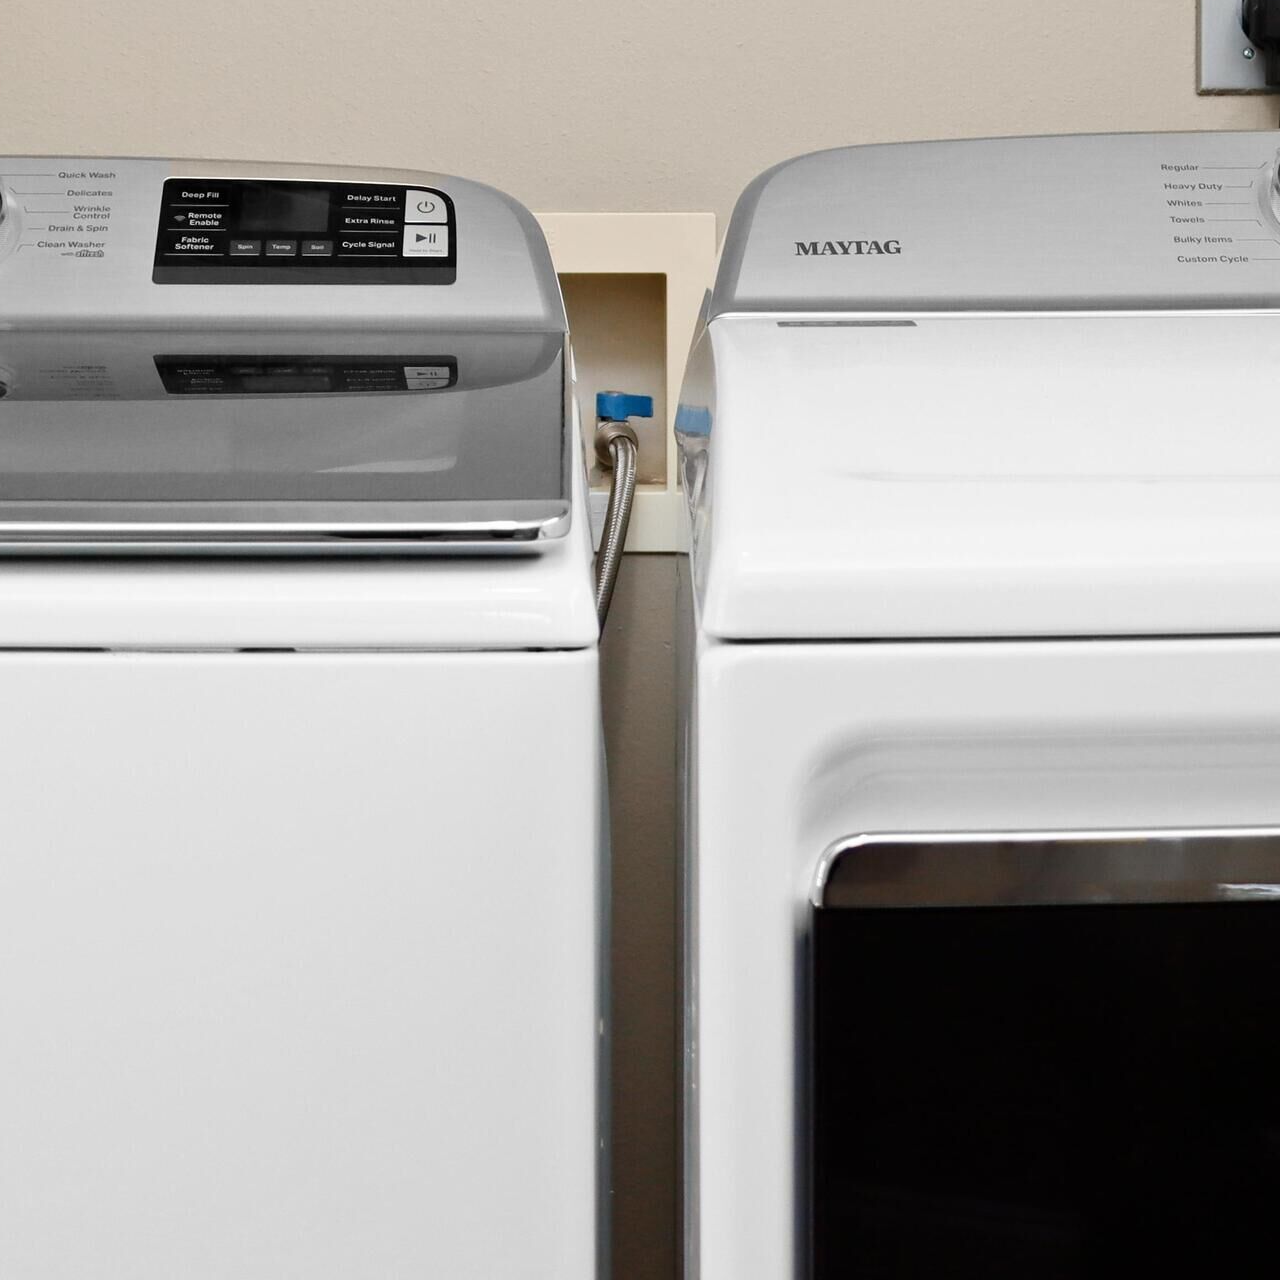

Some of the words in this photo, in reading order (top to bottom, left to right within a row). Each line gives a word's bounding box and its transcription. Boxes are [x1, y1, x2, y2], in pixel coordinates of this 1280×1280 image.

[1160, 163, 1200, 172] Regular
[58, 171, 87, 179] Quick
[88, 171, 116, 179] Wash
[1163, 182, 1196, 191] Heavy
[1198, 182, 1223, 191] Duty
[66, 189, 113, 197] Delicates
[181, 191, 205, 199] Deep
[347, 194, 372, 202] Delay
[73, 212, 110, 220] Control
[85, 224, 109, 232] Spin
[37, 240, 66, 248] Clean
[67, 240, 106, 248] Washer
[181, 236, 209, 244] Fabric
[1173, 235, 1202, 245] Bulky
[1204, 235, 1233, 243] Items
[342, 241, 367, 249] Cycle
[368, 241, 395, 249] Signal
[794, 240, 902, 255] MAYTAG
[1177, 255, 1218, 263] Custom
[1220, 255, 1249, 264] Cycle
